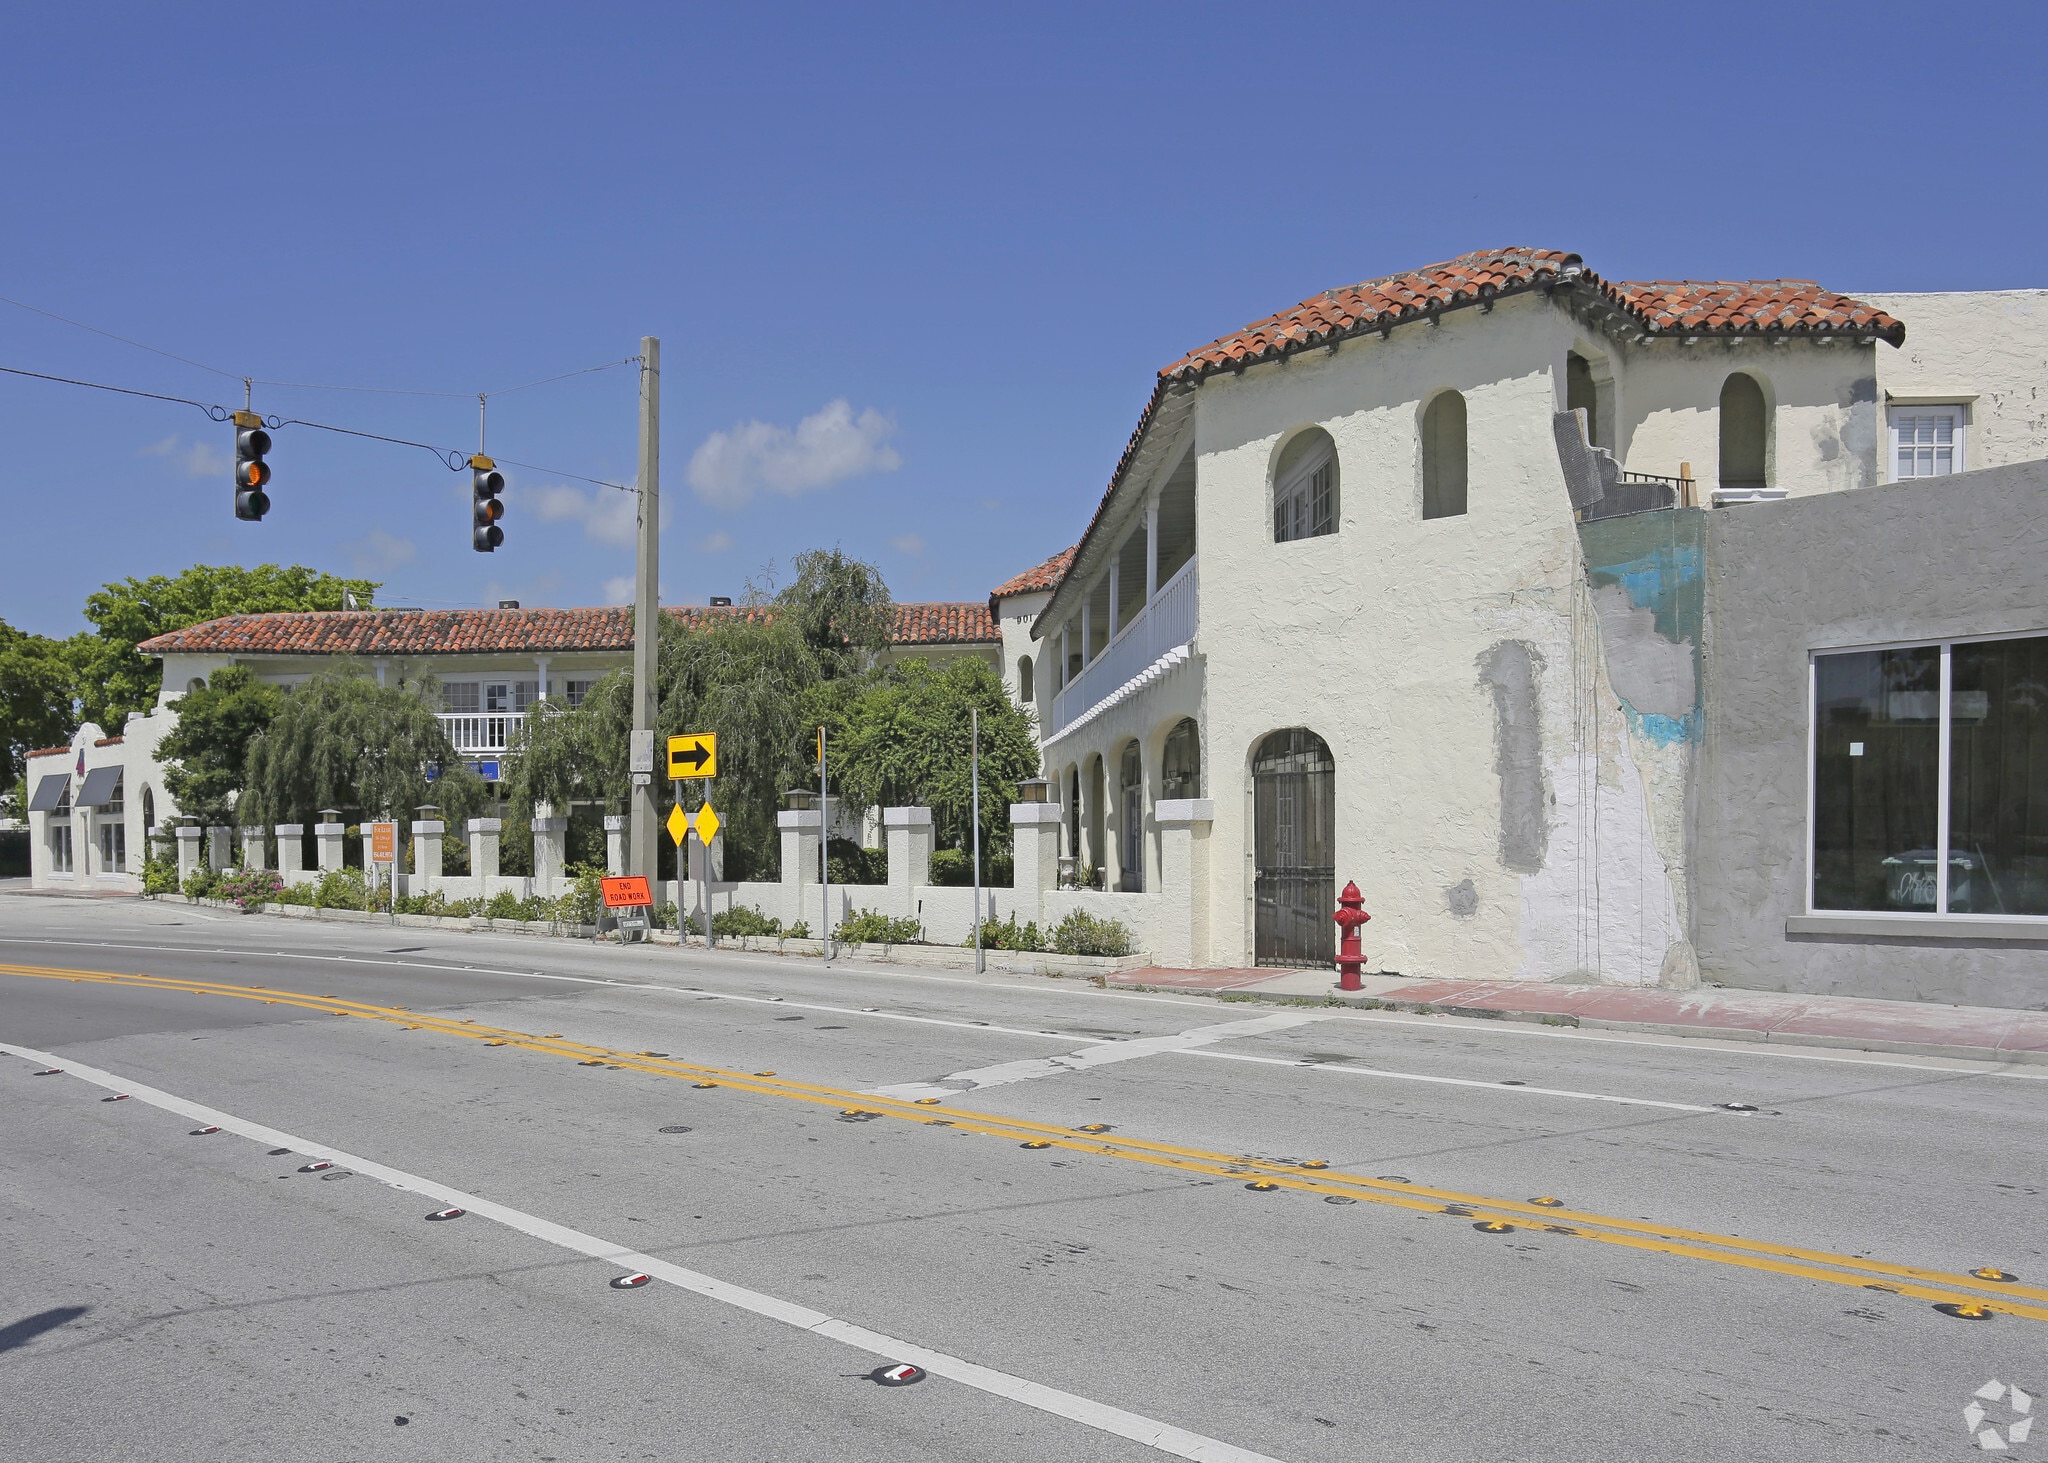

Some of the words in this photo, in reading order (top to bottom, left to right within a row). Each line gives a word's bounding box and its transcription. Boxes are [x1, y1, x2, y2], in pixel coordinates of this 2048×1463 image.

[619, 882, 632, 890] END
[610, 893, 627, 901] ROAD
[628, 892, 646, 900] WORK
